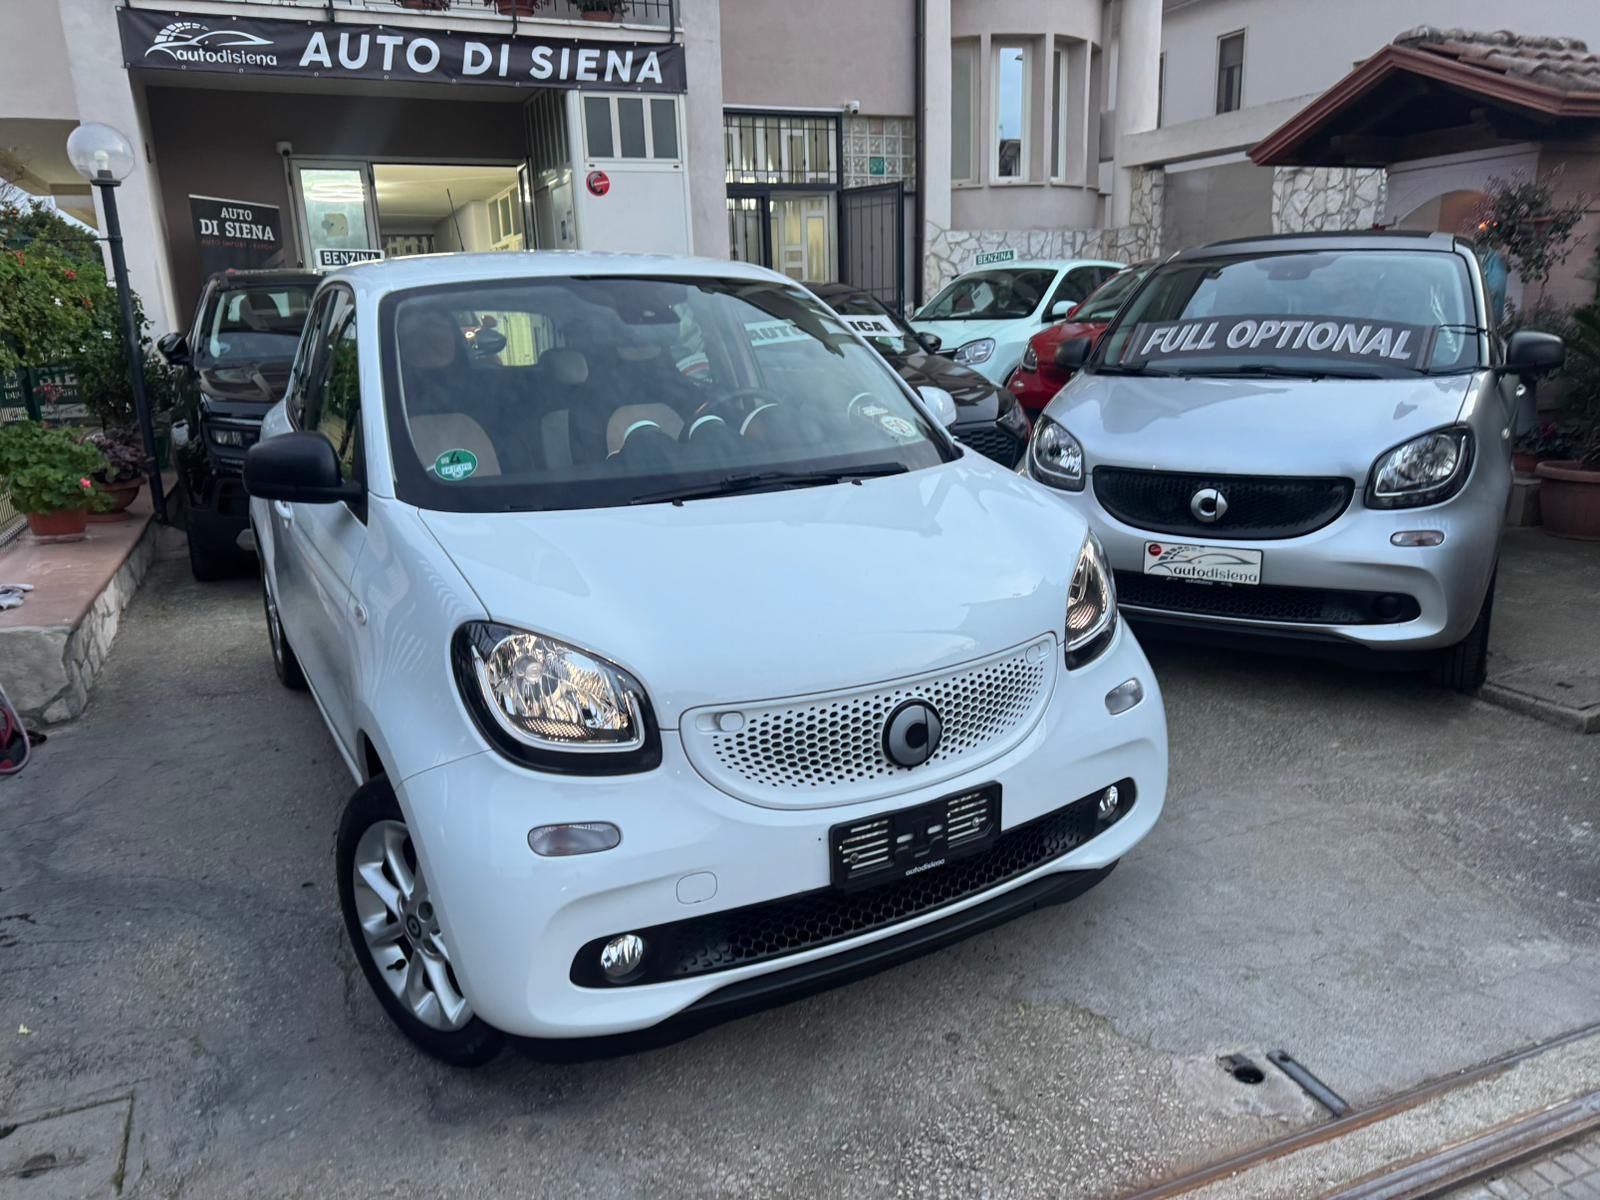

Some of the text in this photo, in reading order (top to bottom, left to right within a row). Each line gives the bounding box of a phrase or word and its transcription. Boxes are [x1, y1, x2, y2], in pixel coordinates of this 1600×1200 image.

[175, 48, 278, 66] autodisiena
[299, 32, 664, 84] AUTO DI SIENA
[220, 207, 253, 221] AUTO
[199, 219, 275, 241] DI SIENA
[323, 251, 377, 265] BENZINA
[977, 250, 1012, 264] BENZINA
[1140, 319, 1412, 360] FULL OPTIONAL
[1173, 566, 1258, 583] autodisiena
